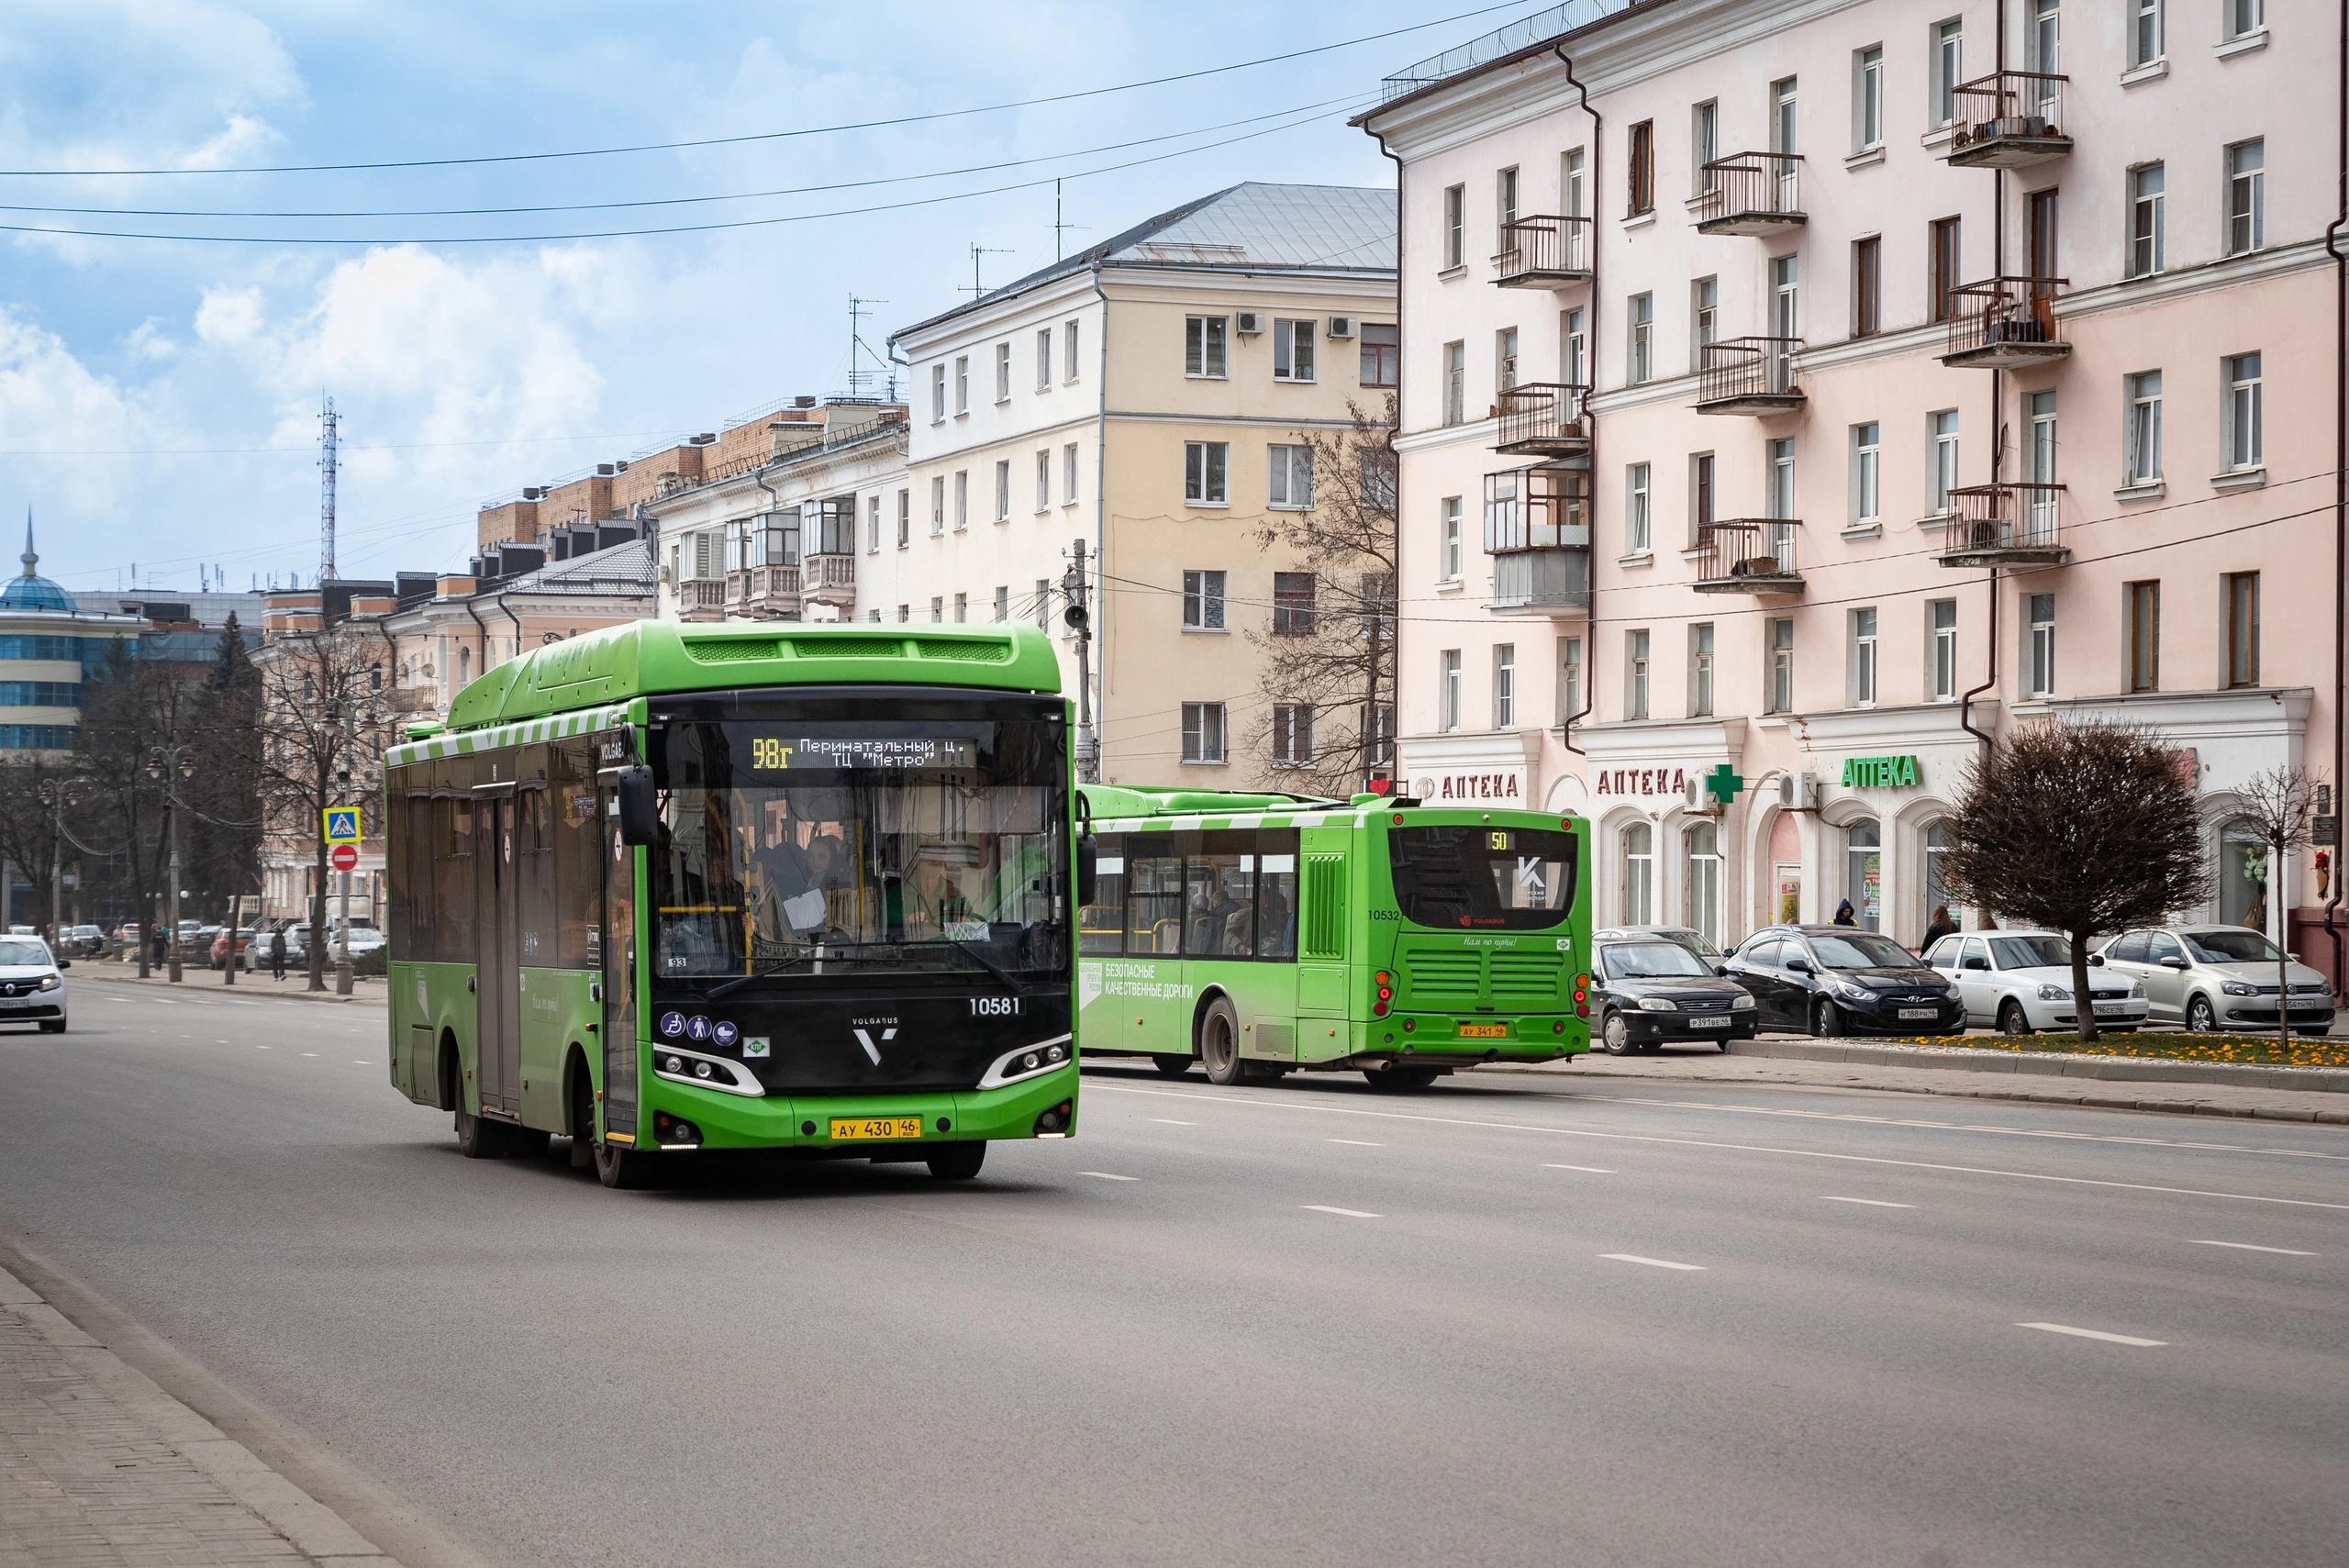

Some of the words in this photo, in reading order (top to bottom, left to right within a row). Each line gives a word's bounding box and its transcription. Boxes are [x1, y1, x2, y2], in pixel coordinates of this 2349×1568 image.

[752, 739, 793, 769] 98г
[800, 739, 935, 754] Перинатальный
[945, 741, 964, 754] ц.
[832, 752, 852, 768] ТЦ
[1841, 755, 1917, 787] АПТЕКА
[1442, 773, 1518, 798] АПТЕКА
[1598, 768, 1686, 795] АПТЕКА
[1491, 831, 1507, 851] 50
[1368, 910, 1399, 920] 10532
[1464, 937, 1481, 945] Нам
[1494, 937, 1517, 950] пути!
[672, 959, 685, 967] 93
[1106, 963, 1154, 979] БЕЗОПАСНЫЕ
[1105, 981, 1162, 997] КАЧЕСТВЕННЫЕ
[1163, 984, 1193, 1000] ДОРОГИ
[970, 997, 1019, 1015] 10581
[1477, 1027, 1492, 1036] 341
[864, 1121, 892, 1136] 430
[901, 1120, 916, 1131] 46
